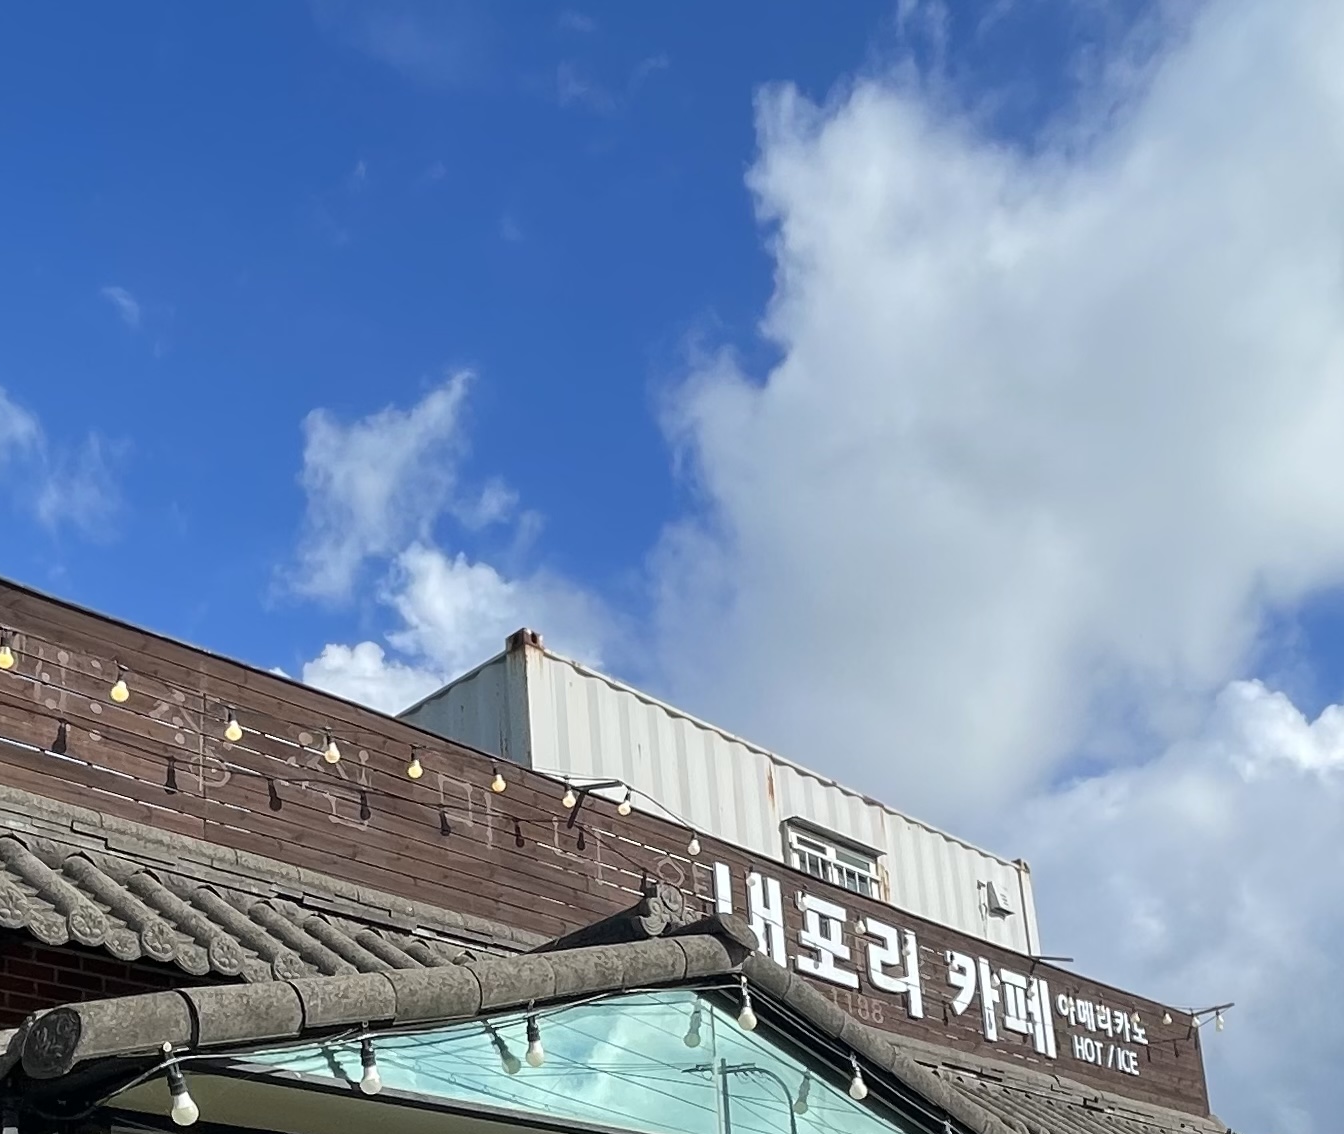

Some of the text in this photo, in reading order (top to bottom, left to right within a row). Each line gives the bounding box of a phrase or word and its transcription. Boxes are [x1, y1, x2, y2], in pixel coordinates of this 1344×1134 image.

[714, 861, 1057, 1058] 내포리 카페
[1057, 993, 1149, 1045] 아메리카노
[1073, 1034, 1104, 1066] HOT
[1116, 1047, 1140, 1076] ICE
